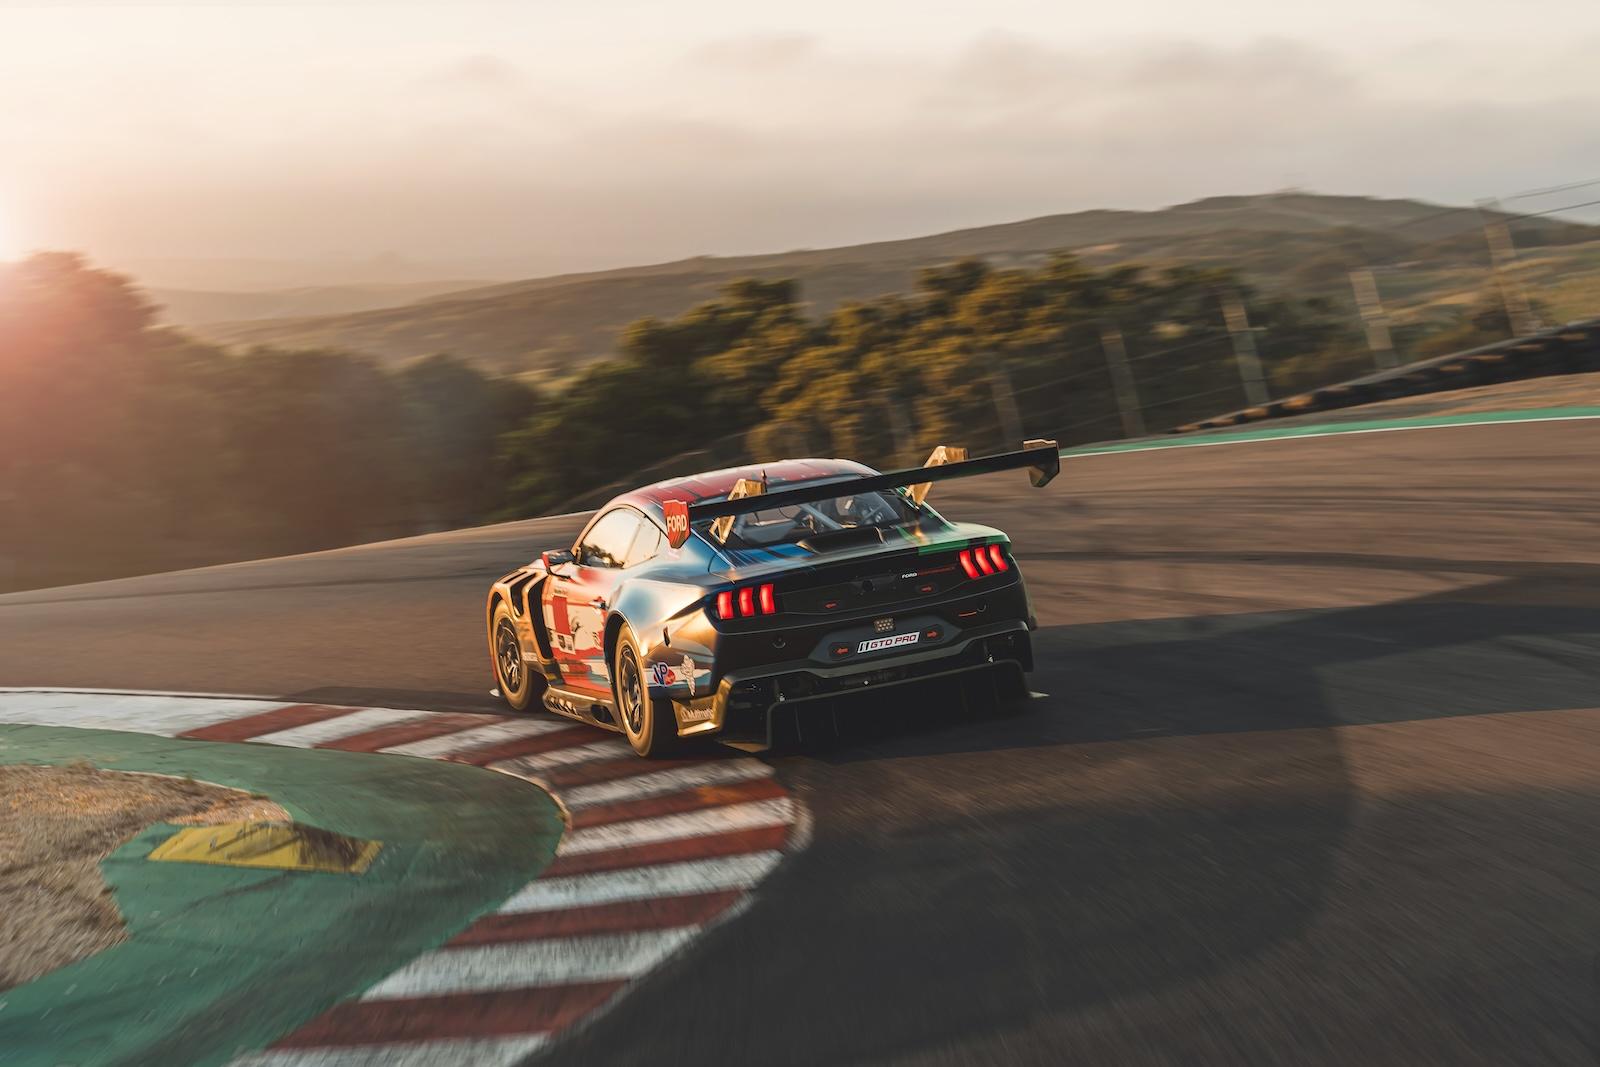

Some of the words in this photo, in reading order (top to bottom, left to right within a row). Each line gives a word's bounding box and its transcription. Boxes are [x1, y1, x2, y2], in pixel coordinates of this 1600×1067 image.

[666, 514, 686, 532] FORD
[870, 639, 892, 648] GTD
[894, 634, 916, 644] PRO
